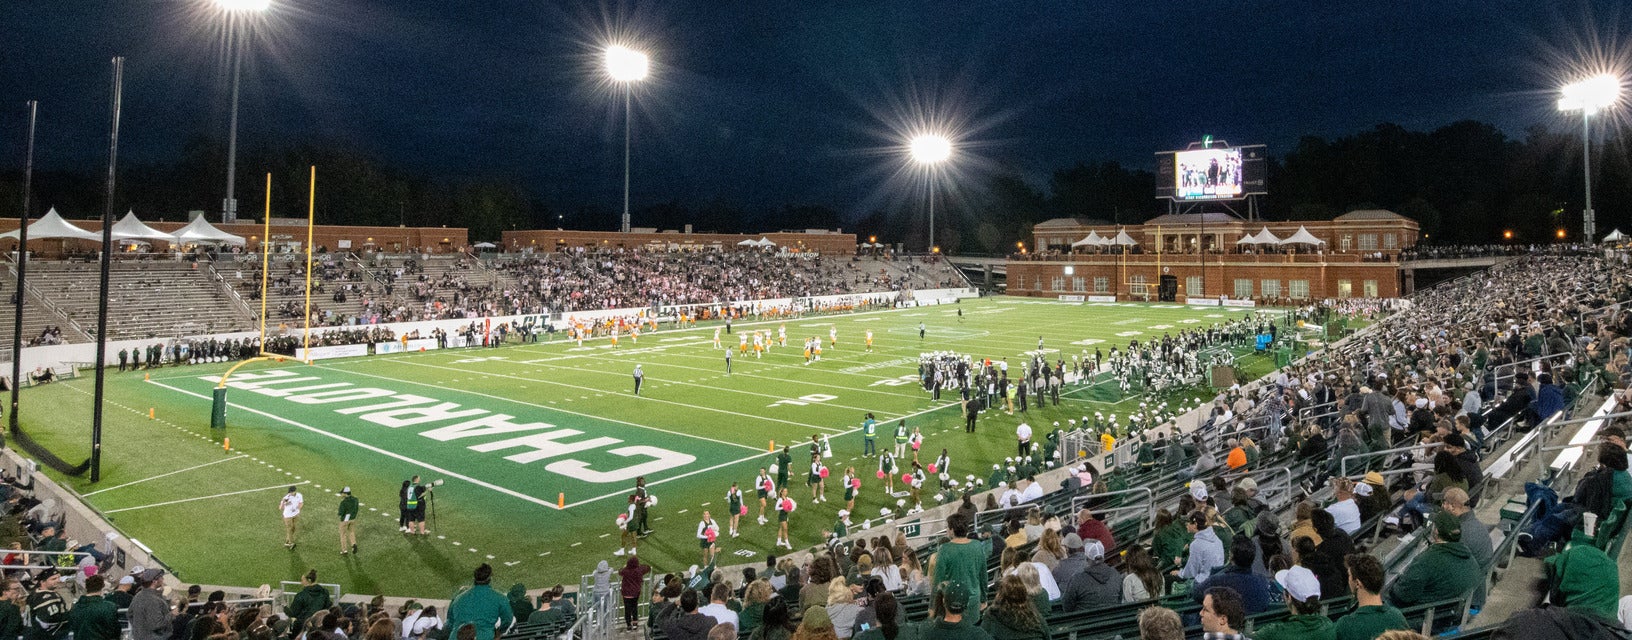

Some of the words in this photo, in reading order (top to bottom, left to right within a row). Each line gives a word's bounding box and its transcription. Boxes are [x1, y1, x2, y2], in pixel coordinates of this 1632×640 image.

[766, 393, 838, 408] 10
[196, 369, 697, 483] CHARLOTTE
[903, 524, 917, 536] 111
